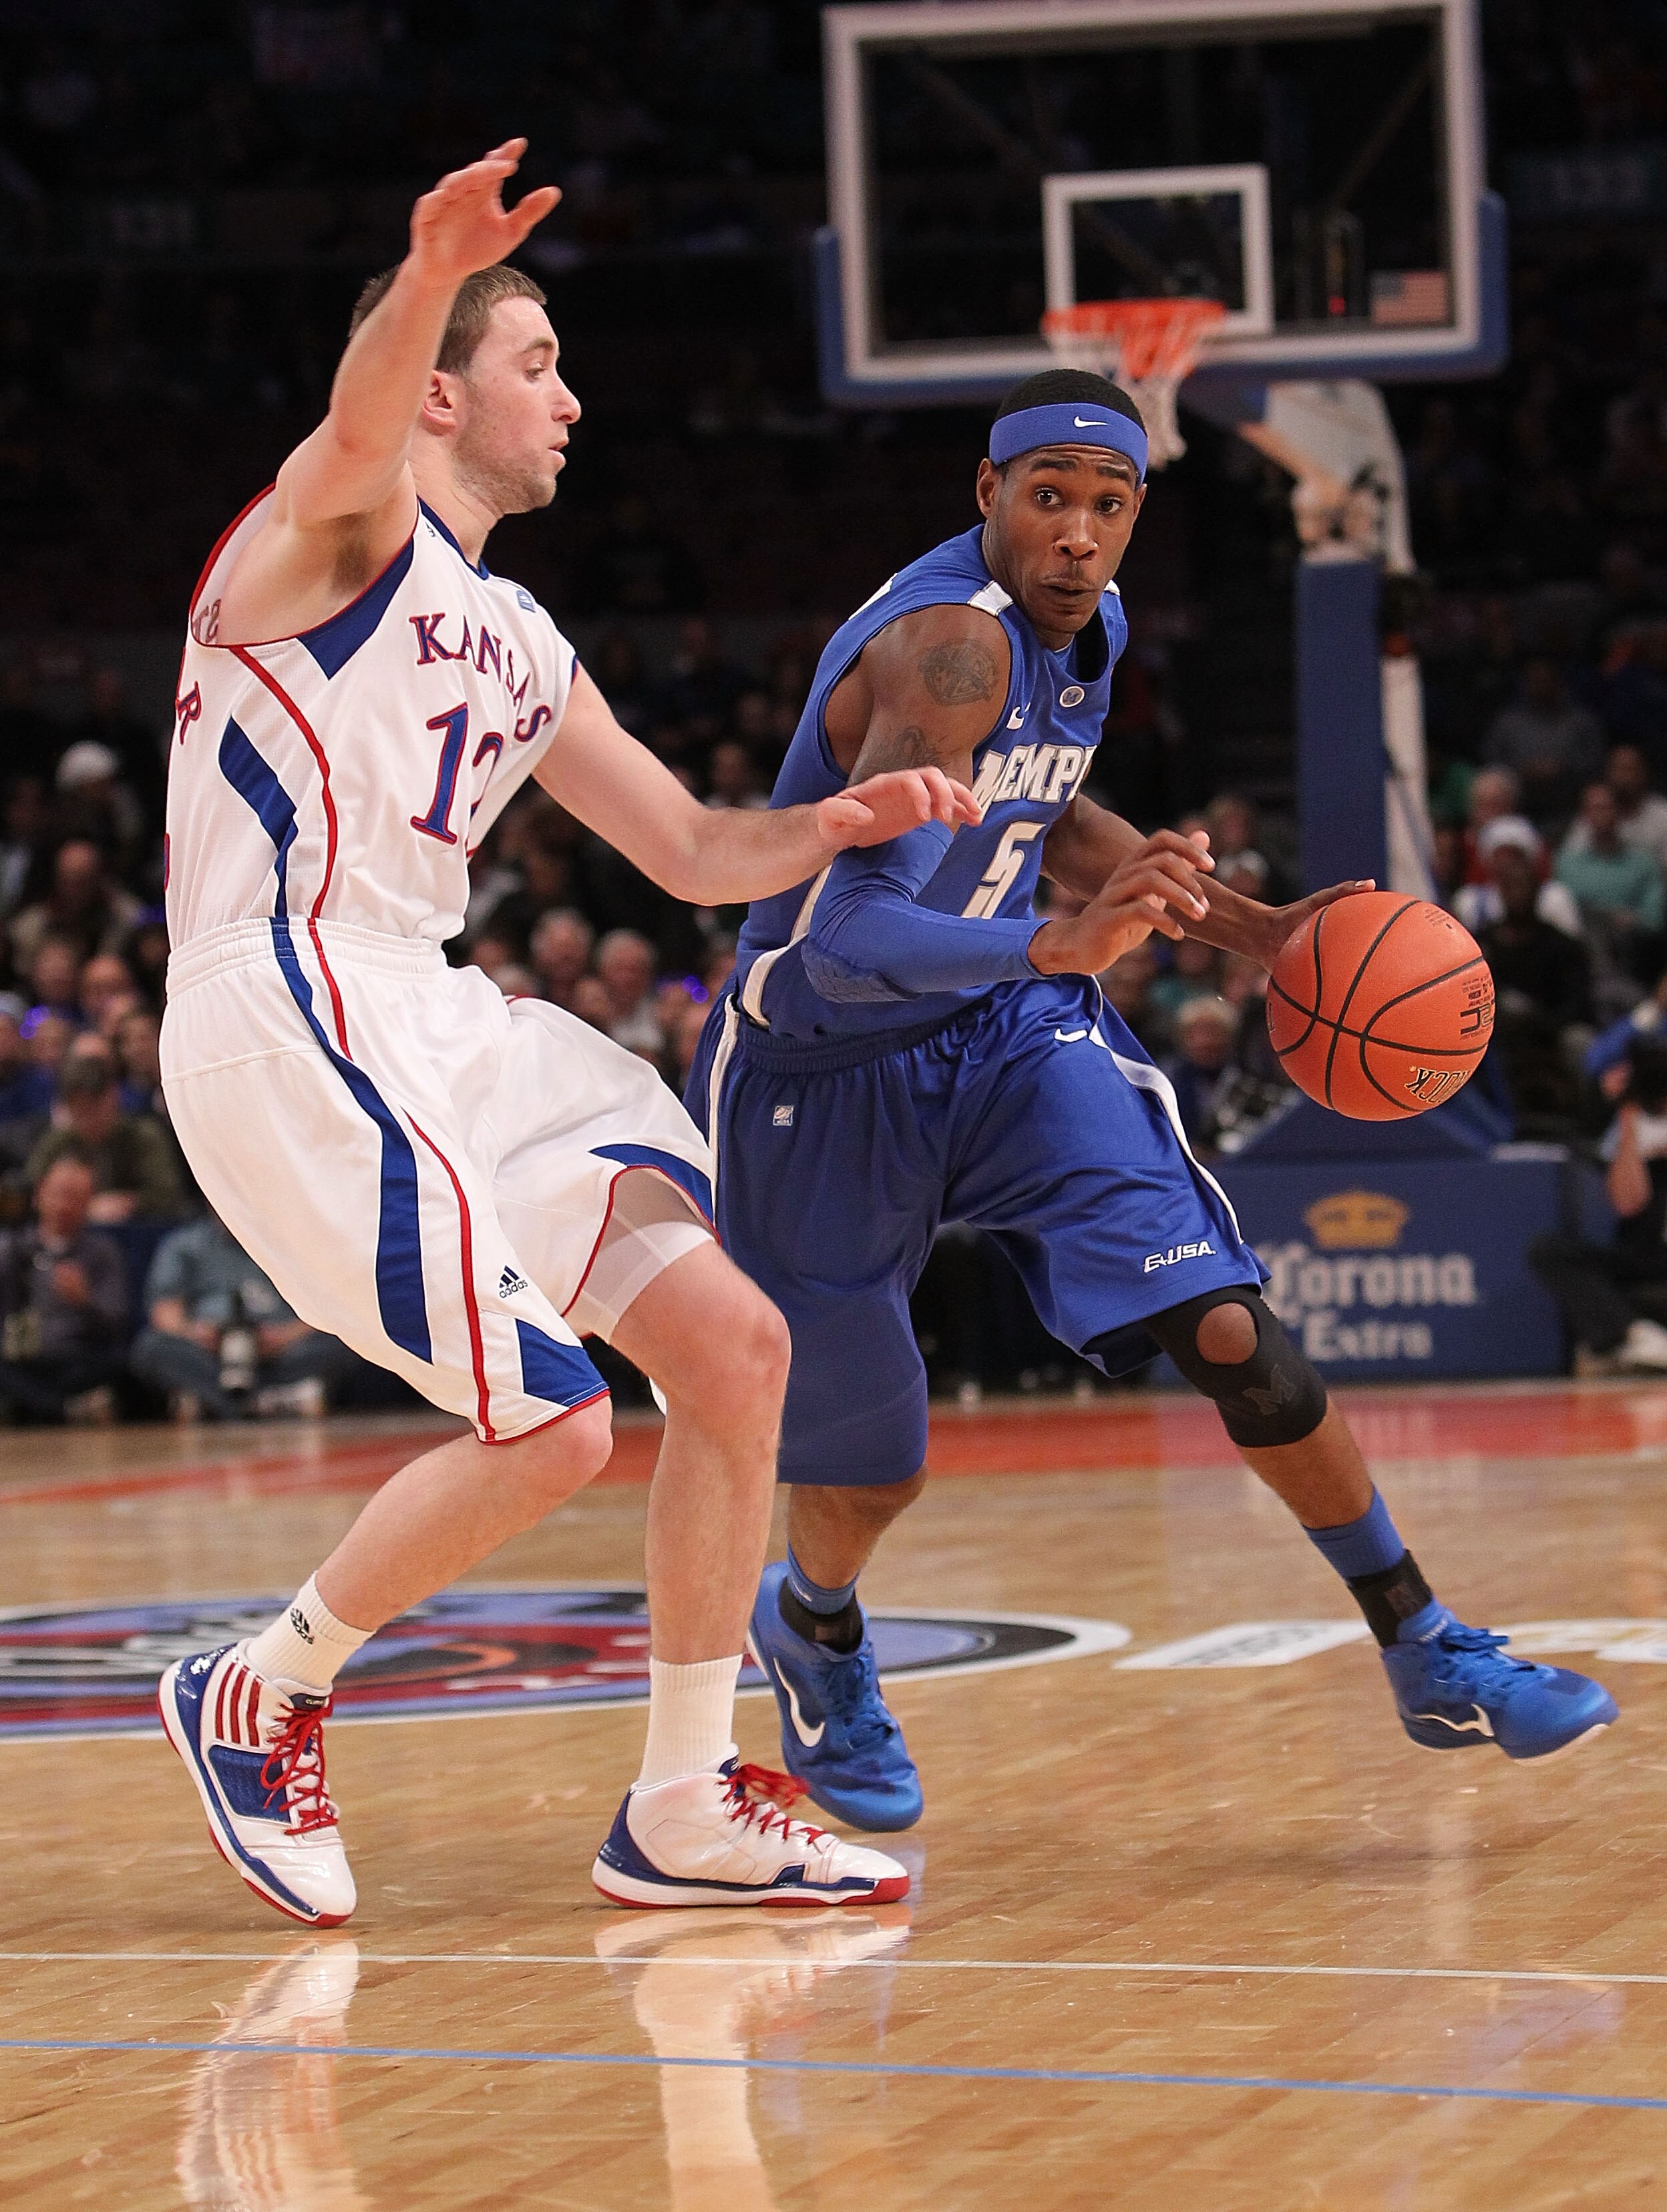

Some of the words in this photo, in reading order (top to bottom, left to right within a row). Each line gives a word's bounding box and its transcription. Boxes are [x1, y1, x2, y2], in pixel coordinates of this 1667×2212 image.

[409, 612, 552, 743] KANSAS
[962, 820, 1047, 920] 5
[499, 1280, 528, 1298] addas
[1254, 1242, 1479, 1326] Corona
[1303, 1312, 1434, 1360] Extra
